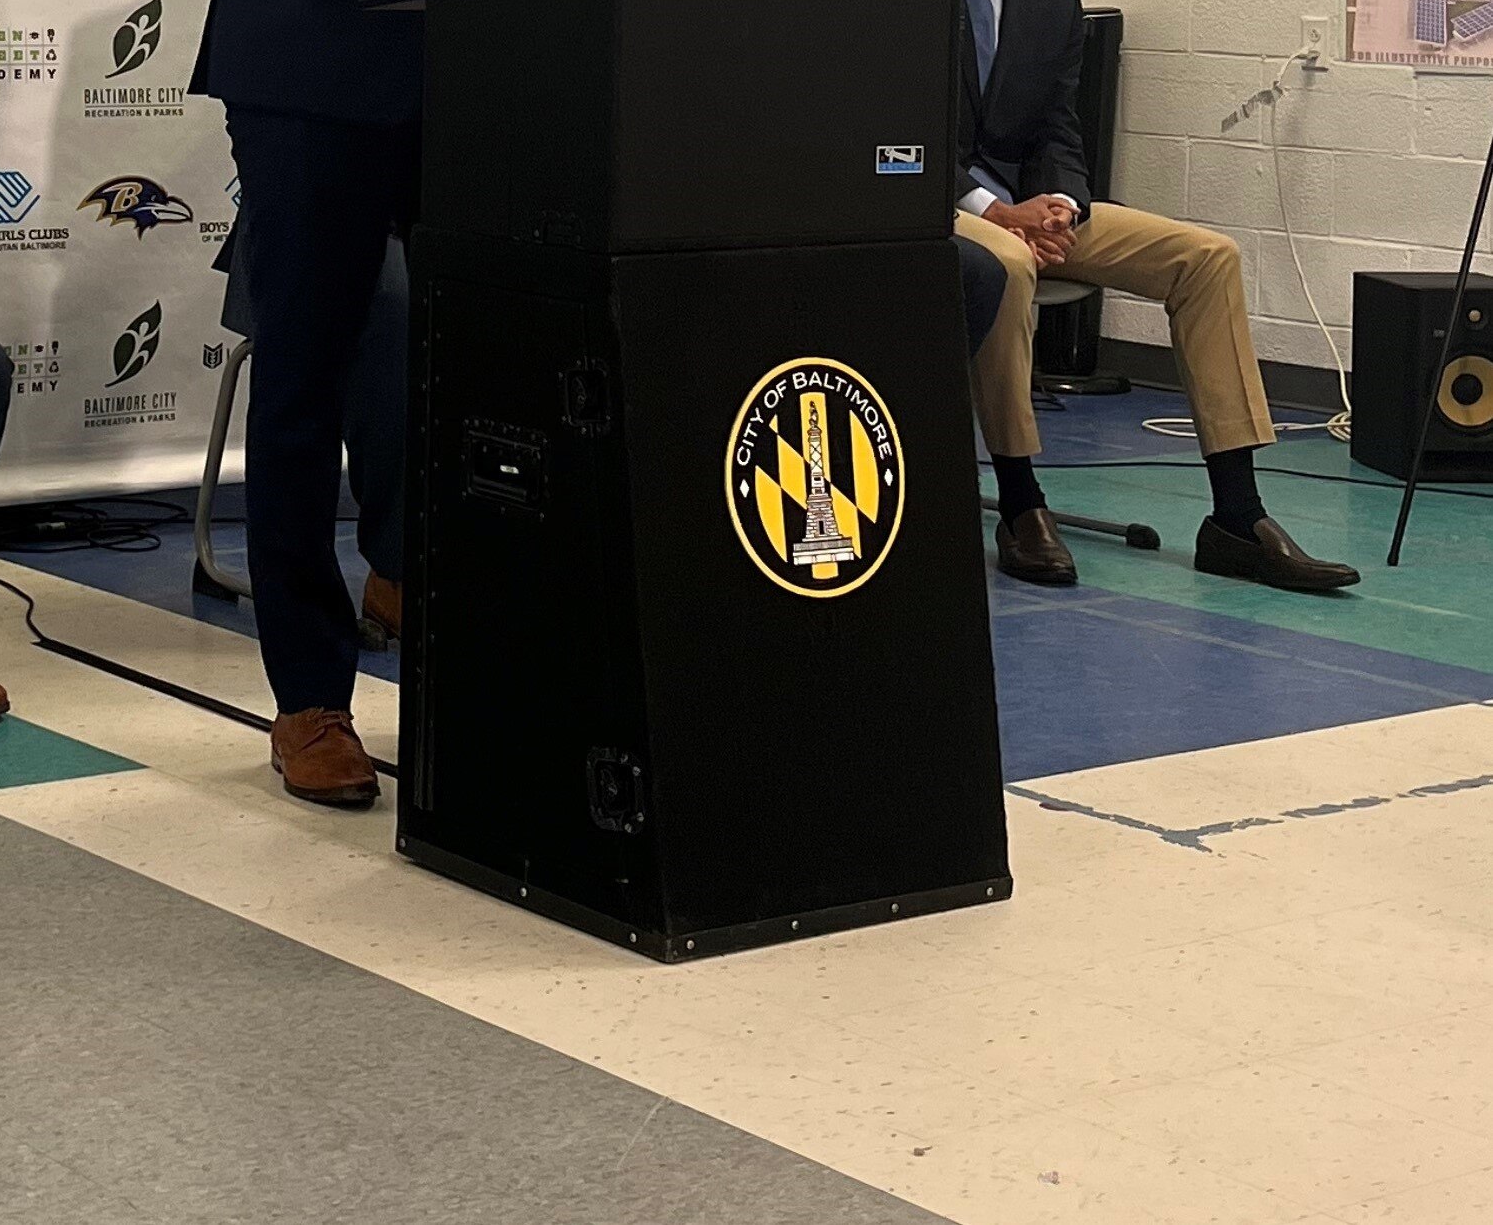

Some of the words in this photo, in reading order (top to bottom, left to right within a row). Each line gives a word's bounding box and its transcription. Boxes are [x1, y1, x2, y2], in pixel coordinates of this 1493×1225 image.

[85, 88, 151, 104] BALTIMORE
[158, 88, 184, 103] CITY
[85, 109, 141, 118] RECREATION
[154, 108, 183, 116] PARKS
[29, 228, 69, 241] CLUBS
[200, 223, 229, 233] BOYS
[85, 395, 147, 414] BALTIMORE
[152, 393, 176, 409] CITY
[737, 407, 764, 466] CITY
[764, 380, 787, 408] OF
[793, 372, 892, 460] BALTIMORE
